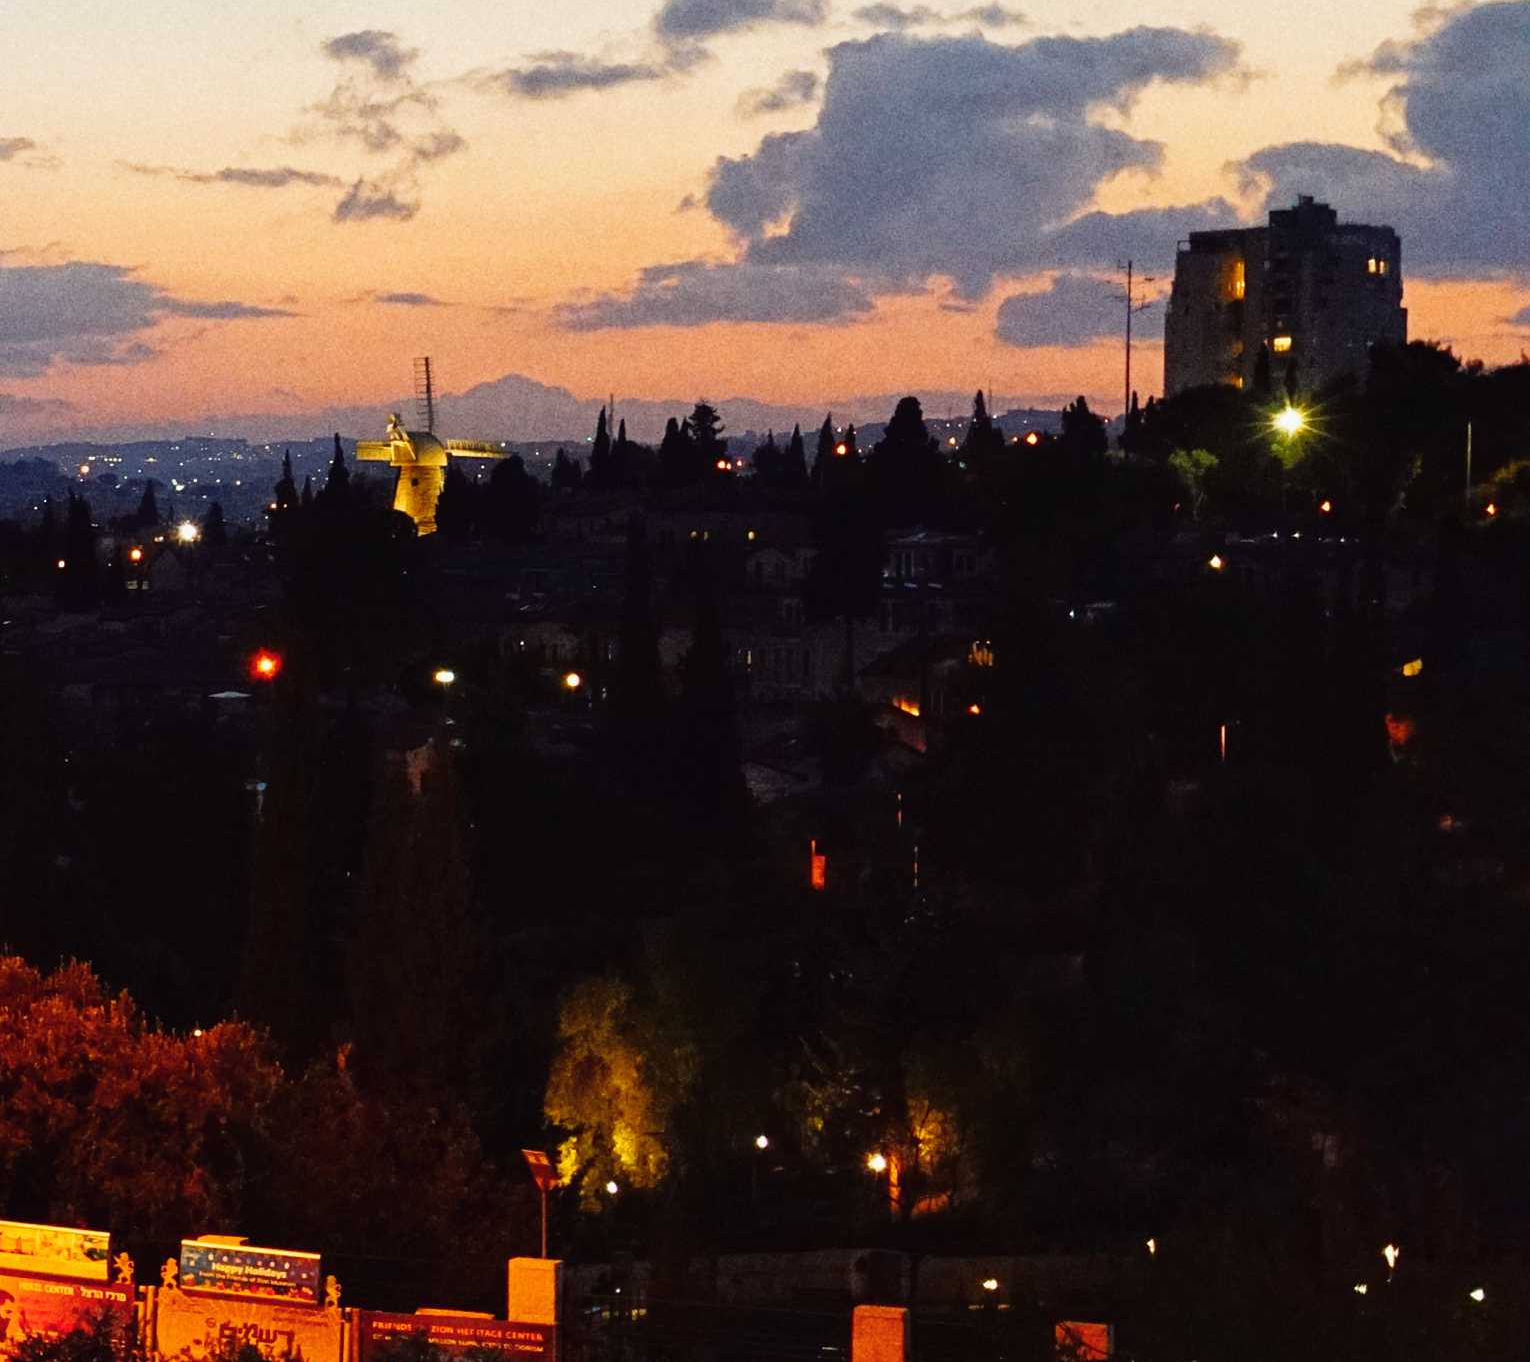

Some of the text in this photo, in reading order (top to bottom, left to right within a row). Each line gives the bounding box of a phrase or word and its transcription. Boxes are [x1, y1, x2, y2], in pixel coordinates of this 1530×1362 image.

[211, 1262, 287, 1279] Happy Holidays
[431, 1325, 454, 1335] ZION
[505, 1330, 544, 1342] CENTER
